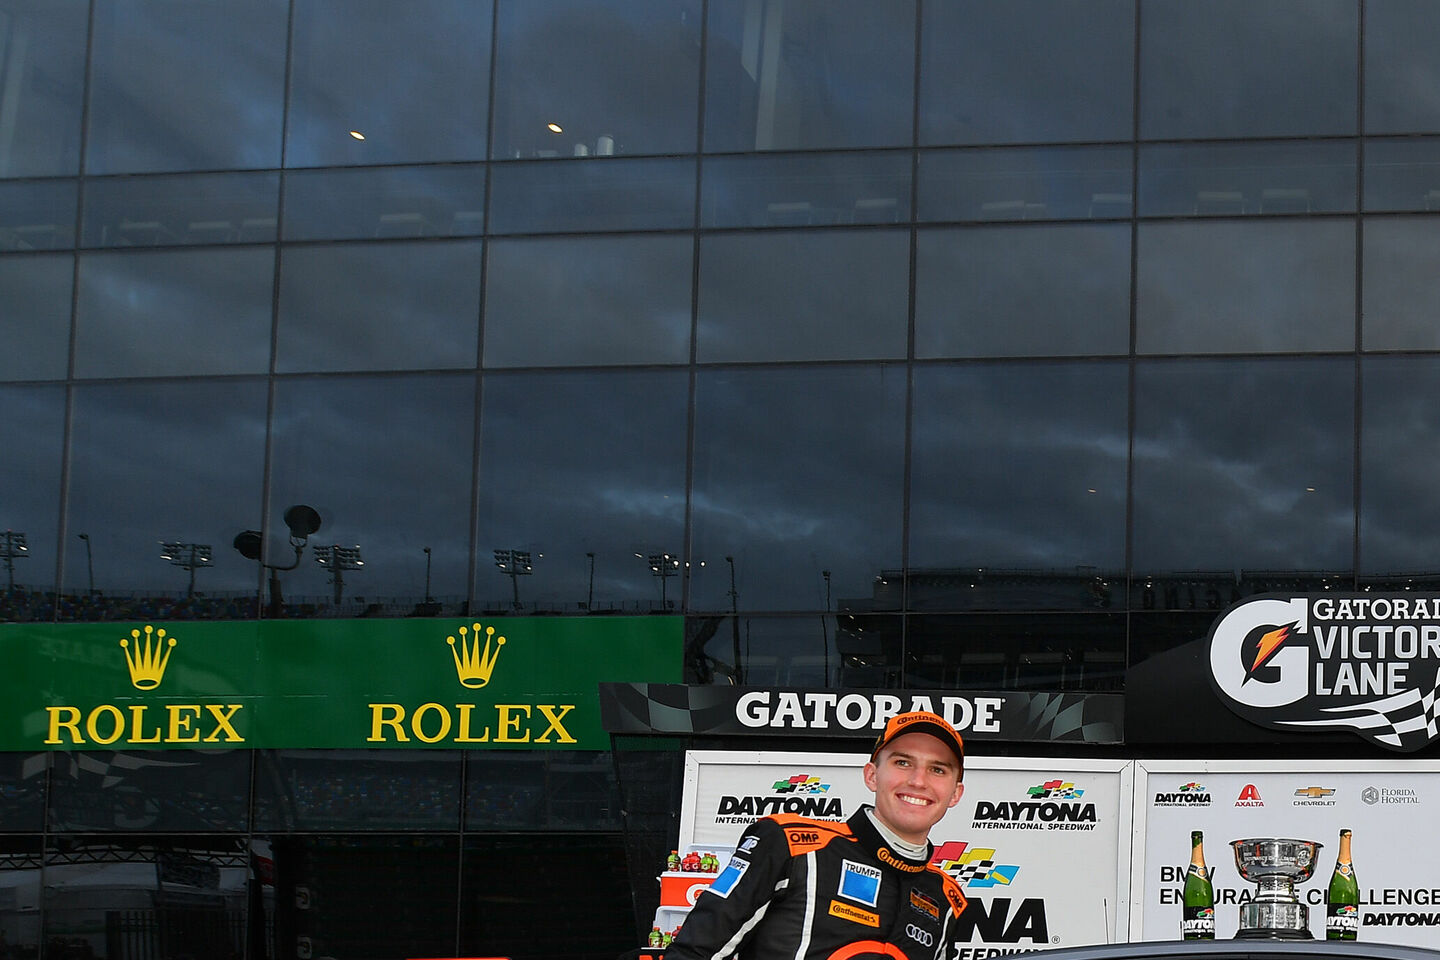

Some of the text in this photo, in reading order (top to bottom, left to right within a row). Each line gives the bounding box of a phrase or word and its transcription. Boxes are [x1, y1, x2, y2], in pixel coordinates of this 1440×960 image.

[1316, 662, 1409, 695] LANE
[44, 704, 245, 745] ROLEX
[367, 703, 577, 744] ROLEX
[717, 796, 843, 817] DAYTONA
[1154, 793, 1211, 803] DAYTONA
[974, 801, 1097, 823] DAYTONA
[972, 822, 1096, 831] INTERNATIONAL SPEEDWAY
[790, 833, 819, 842] OMP
[845, 863, 880, 878] TRUMPF
[832, 904, 871, 922] Continental
